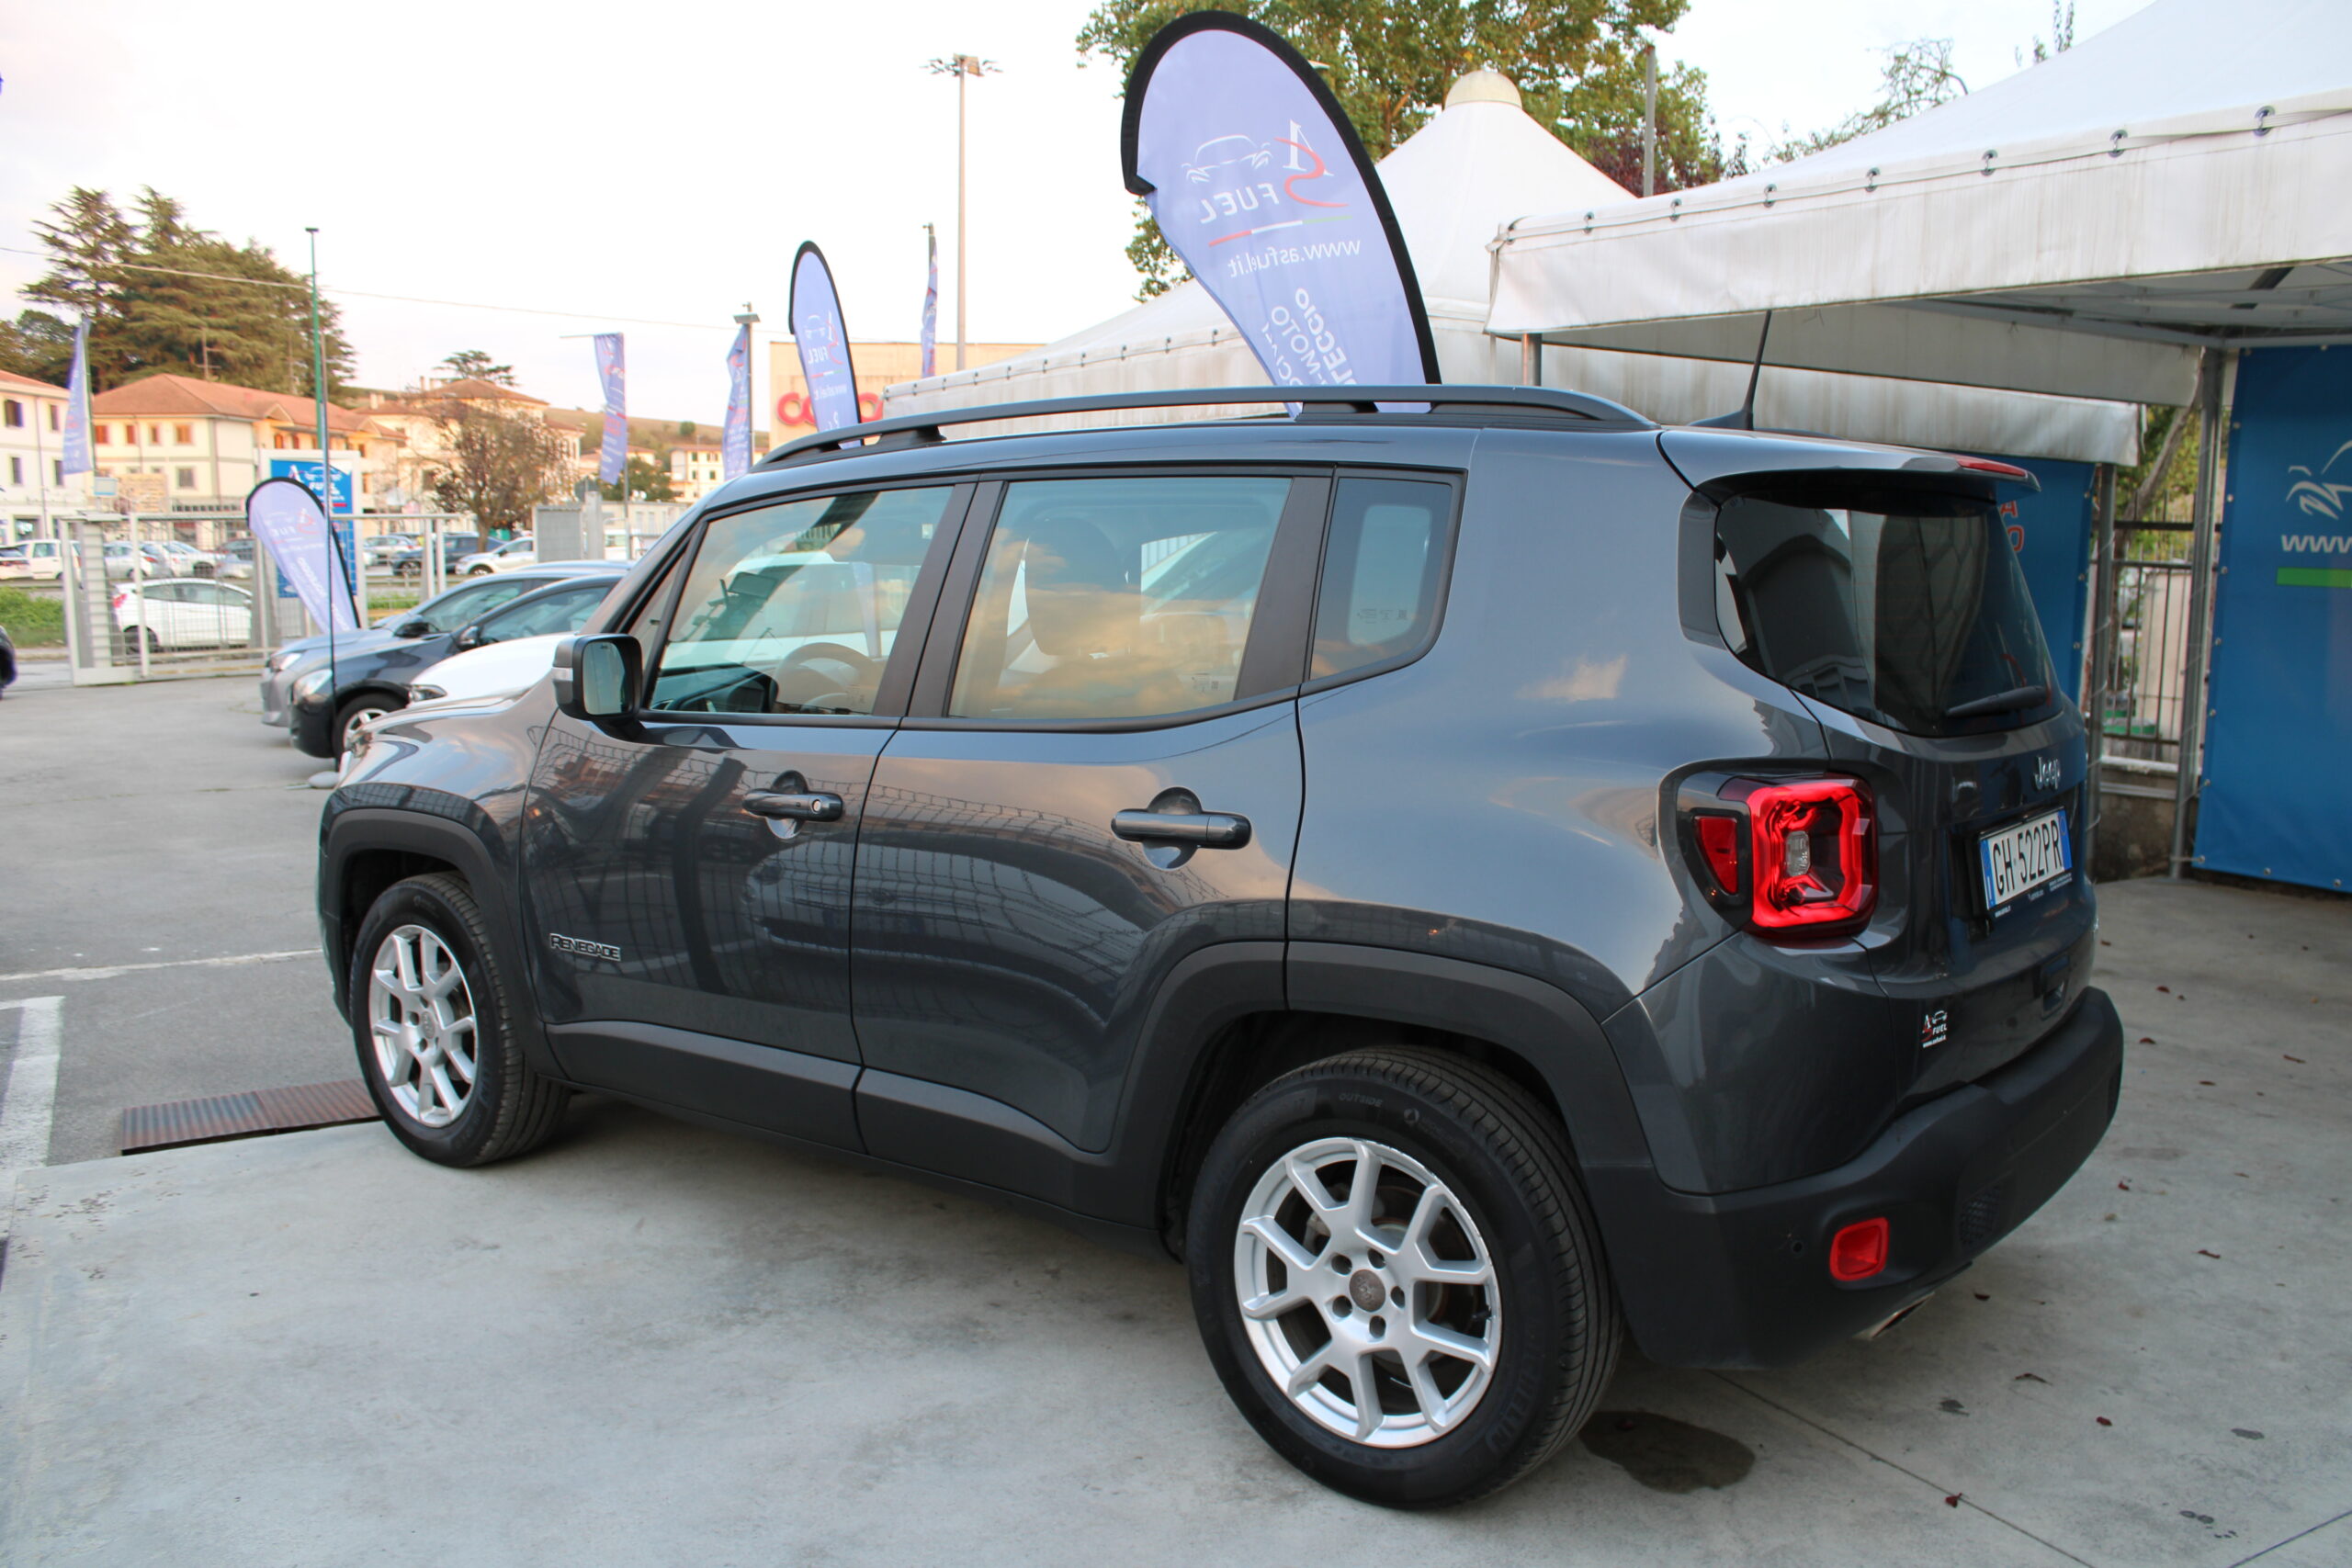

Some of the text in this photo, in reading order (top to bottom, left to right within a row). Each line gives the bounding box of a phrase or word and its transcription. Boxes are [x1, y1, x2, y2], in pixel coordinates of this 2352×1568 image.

[2033, 755, 2062, 790] Jeep
[549, 932, 621, 962] RENEGADE
[1338, 1091, 1385, 1109] OUTSIDE
